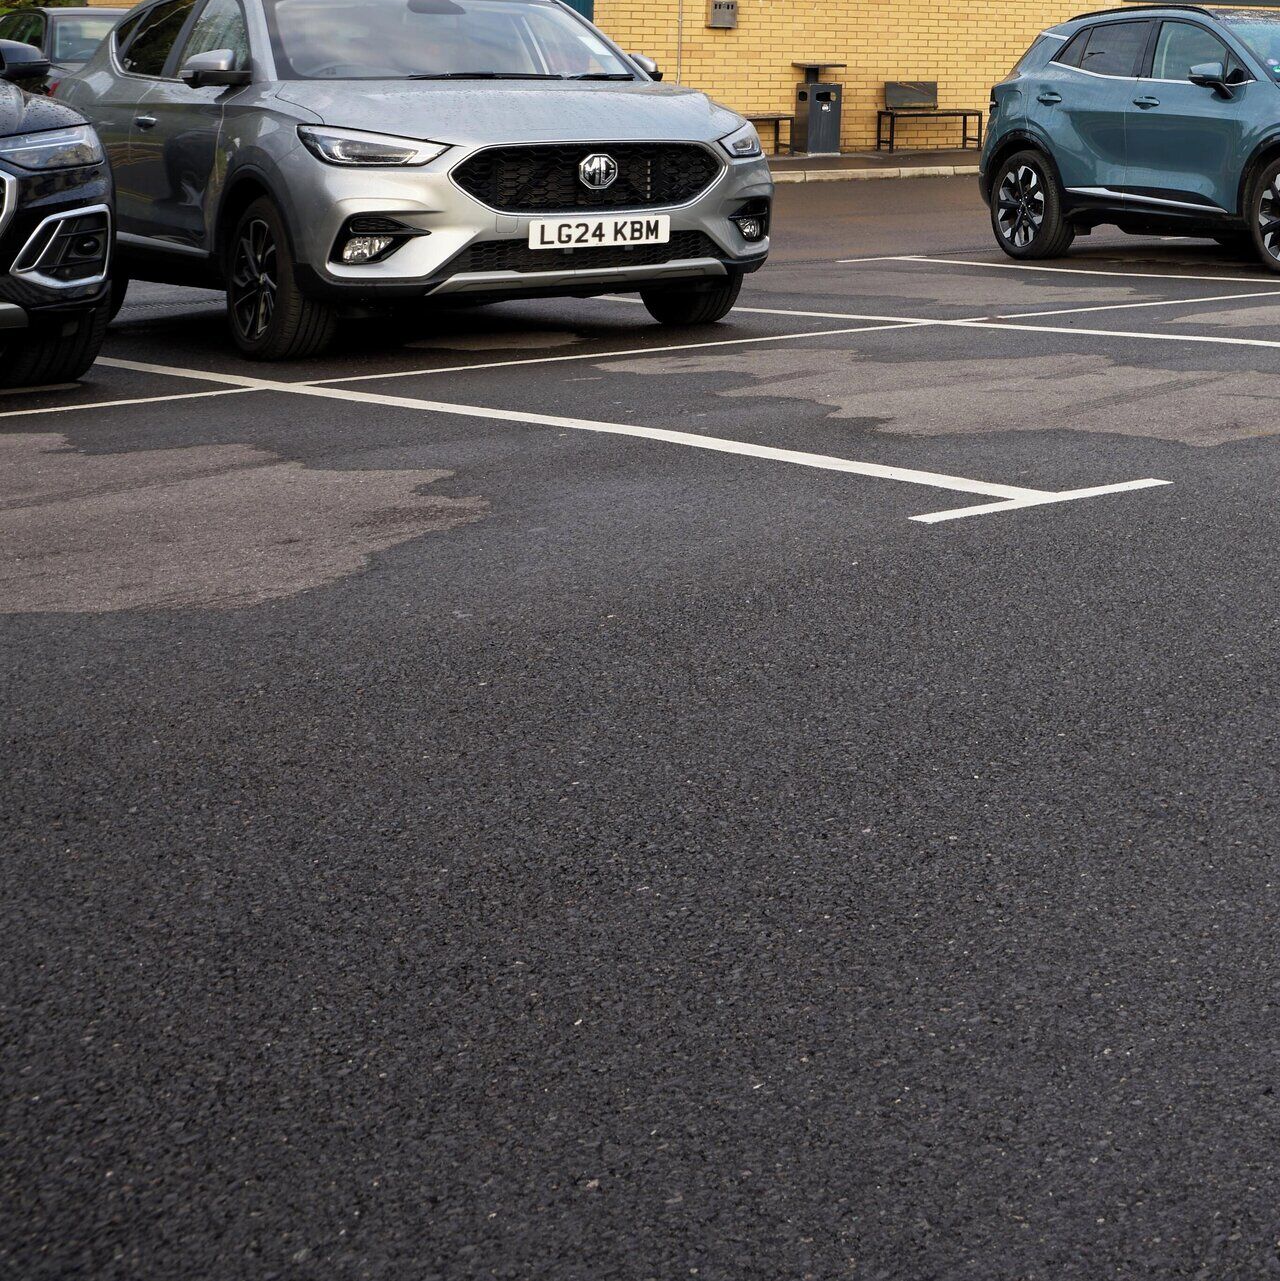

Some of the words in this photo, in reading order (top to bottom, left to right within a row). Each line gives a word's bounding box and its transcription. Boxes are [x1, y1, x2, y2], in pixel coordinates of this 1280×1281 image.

[585, 157, 615, 185] MG
[540, 222, 605, 246] LG24
[613, 219, 659, 242] KBM
